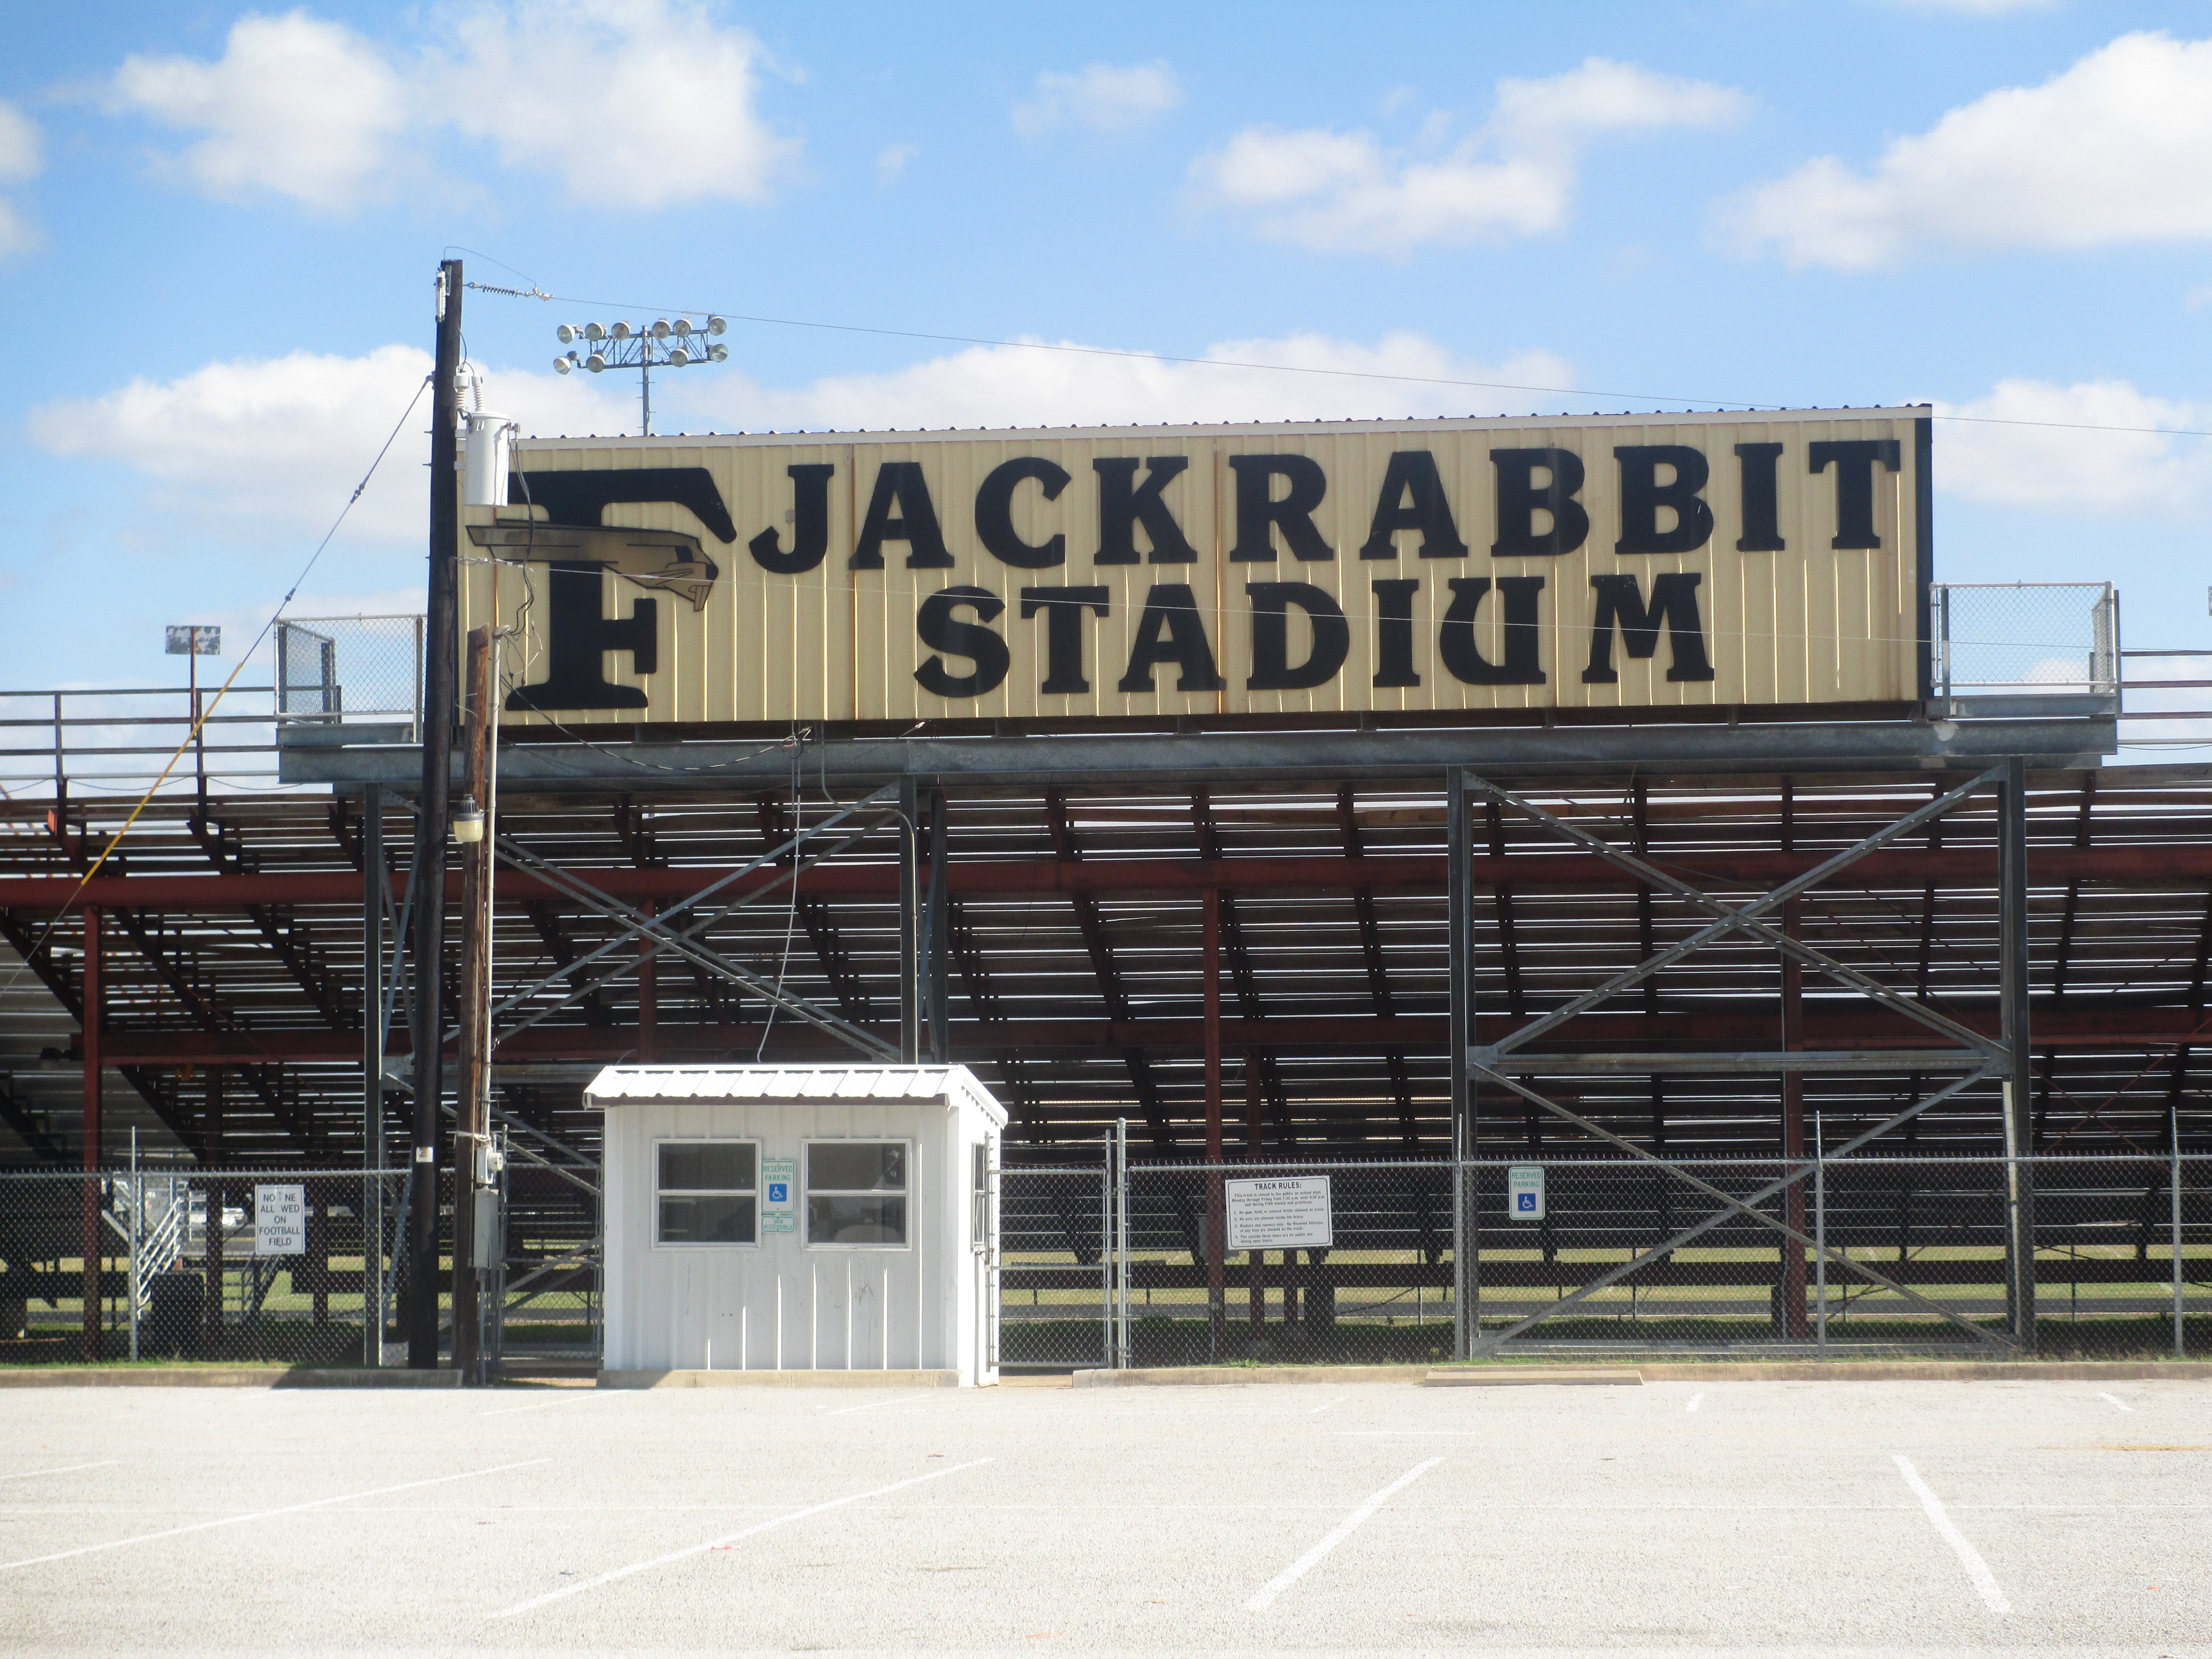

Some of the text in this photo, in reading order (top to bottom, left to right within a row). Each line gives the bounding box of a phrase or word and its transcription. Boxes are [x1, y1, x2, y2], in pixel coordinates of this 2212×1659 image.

[748, 439, 1901, 575] JACKRABBIT
[912, 572, 1715, 698] STADIUM
[263, 1194, 275, 1202] NO
[260, 1204, 300, 1213] ALLWED
[274, 1215, 286, 1224] ON
[259, 1226, 301, 1235] FOOTBALL
[268, 1237, 291, 1246] FIELD
